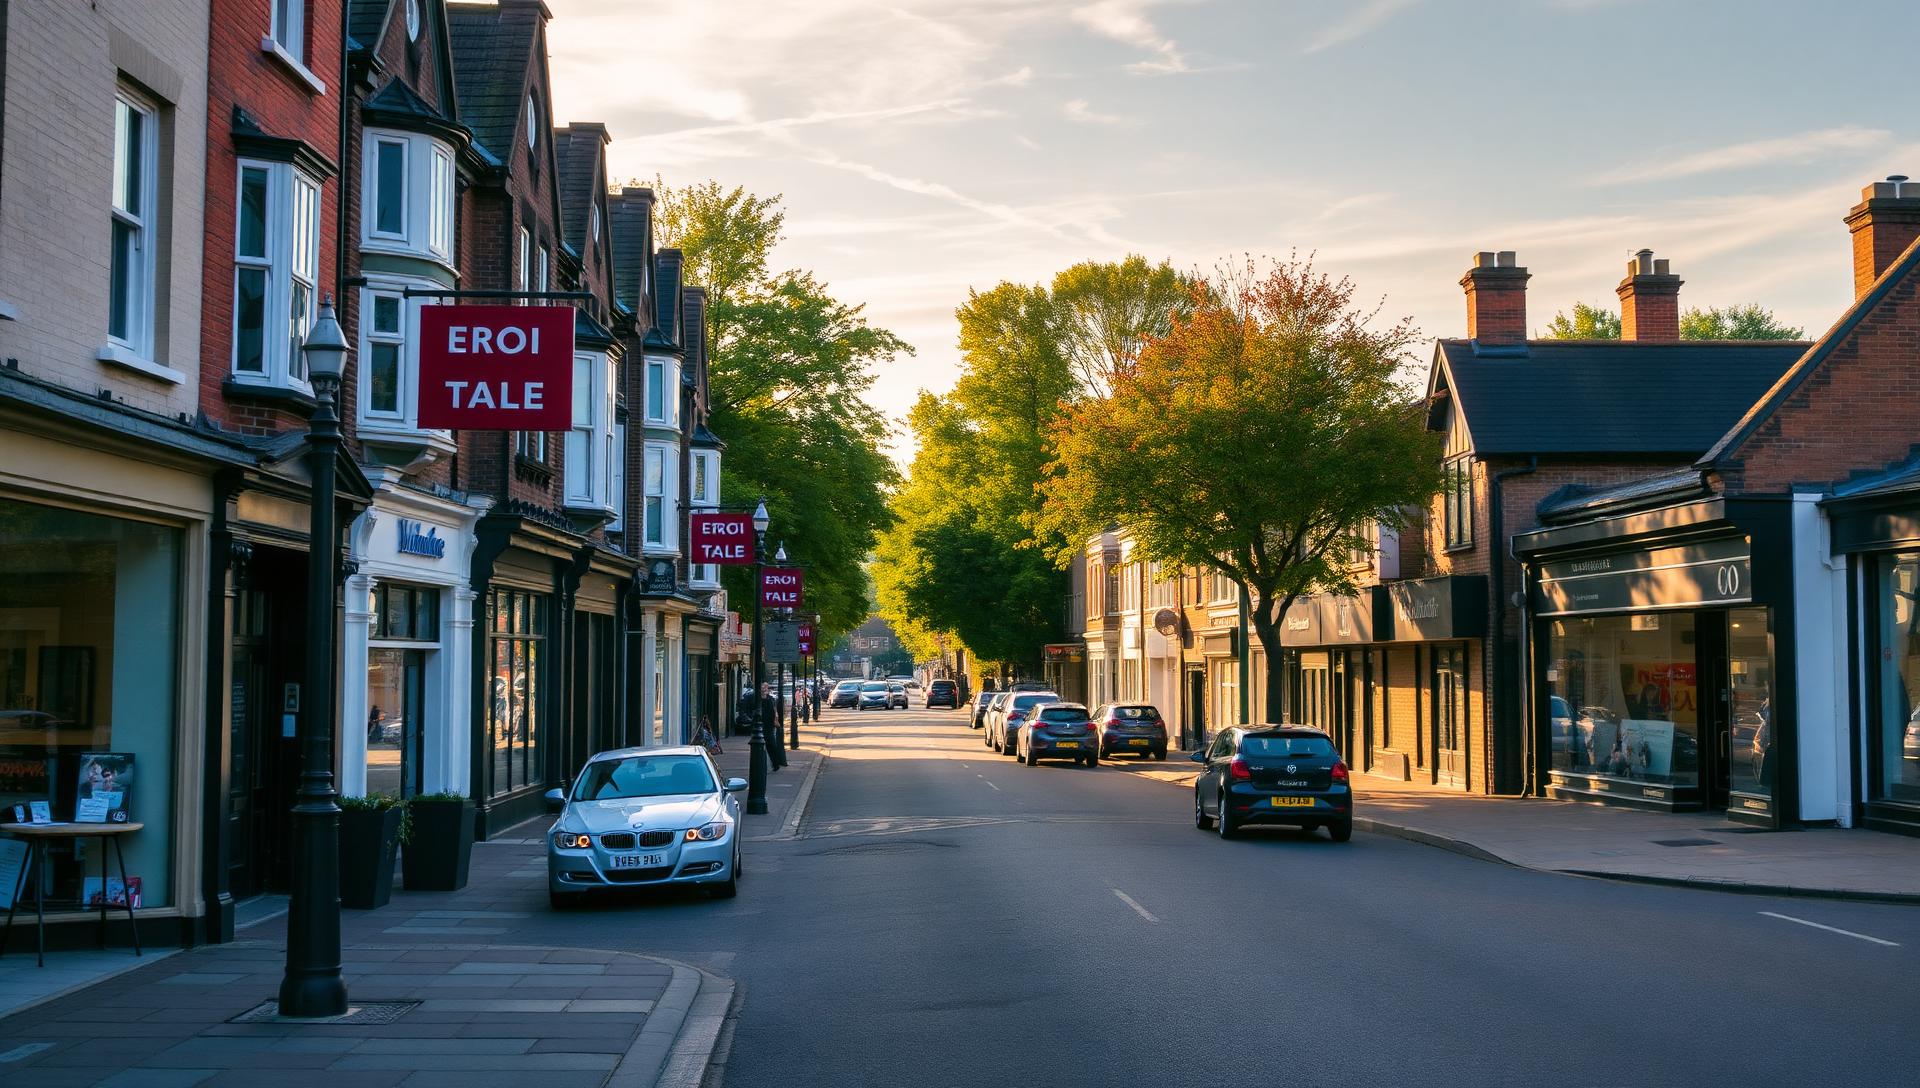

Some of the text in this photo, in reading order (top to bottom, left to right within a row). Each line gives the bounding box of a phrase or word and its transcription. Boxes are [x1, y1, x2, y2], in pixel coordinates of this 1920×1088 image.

[448, 326, 540, 355] EROI
[445, 381, 544, 410] TALE
[702, 544, 744, 559] TALE
